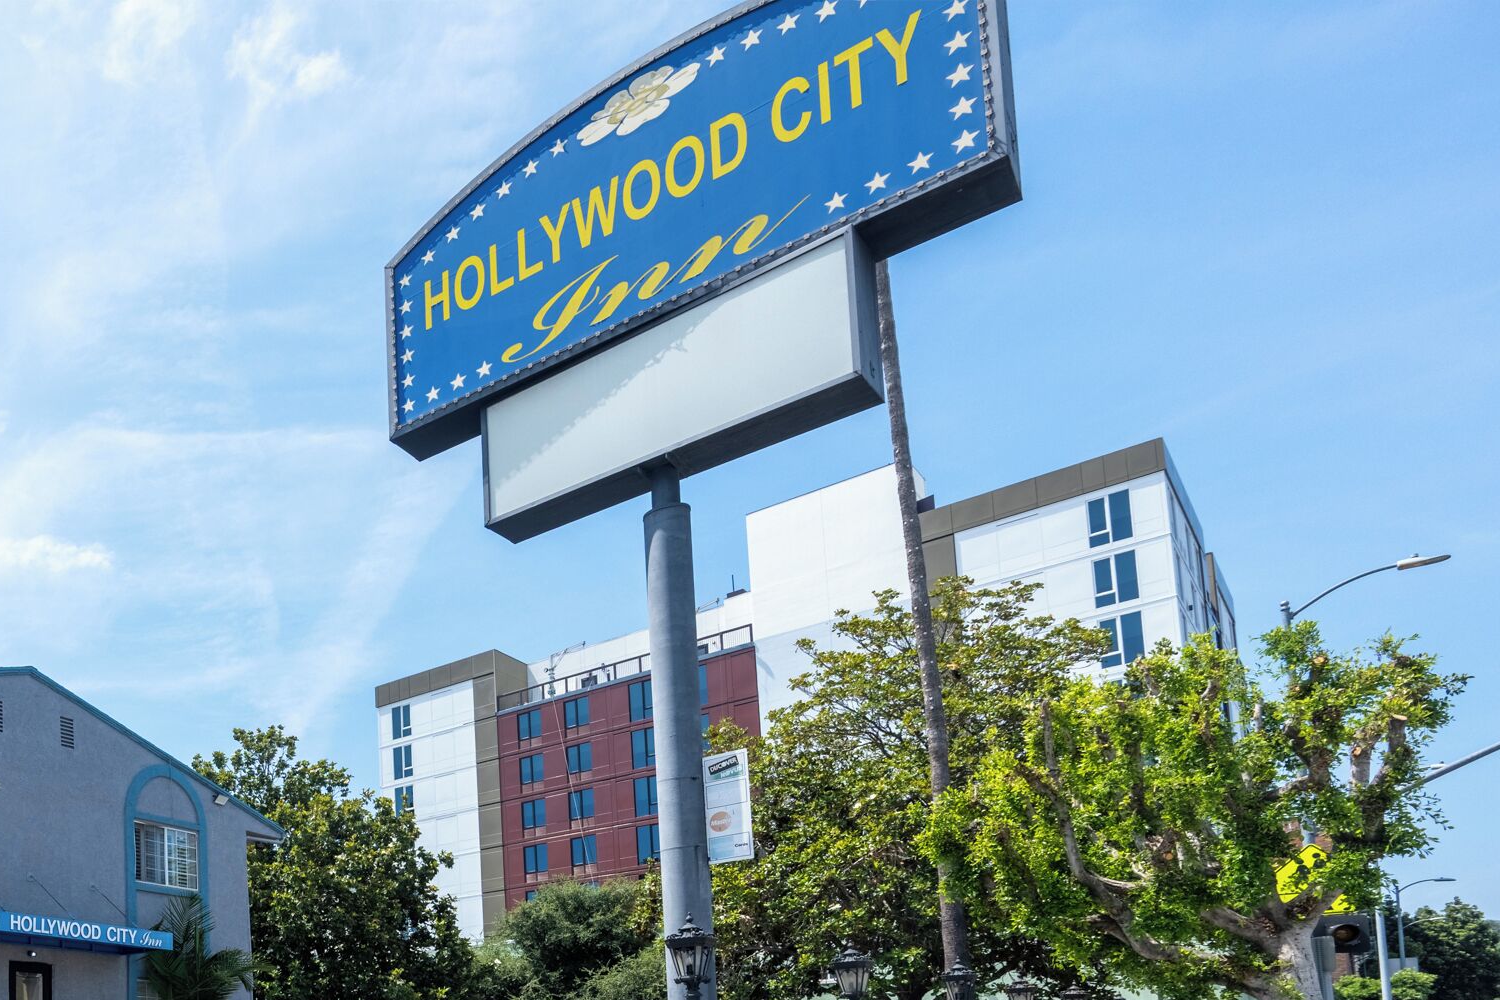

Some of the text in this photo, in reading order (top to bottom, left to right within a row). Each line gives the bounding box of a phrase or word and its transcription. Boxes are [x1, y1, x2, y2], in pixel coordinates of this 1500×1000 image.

[424, 9, 923, 331] HOLLYWOOD CITY
[501, 193, 812, 364] Inn
[10, 914, 101, 940] HOLLYWOOD
[106, 926, 138, 944] CITY
[139, 930, 163, 948] Inn
